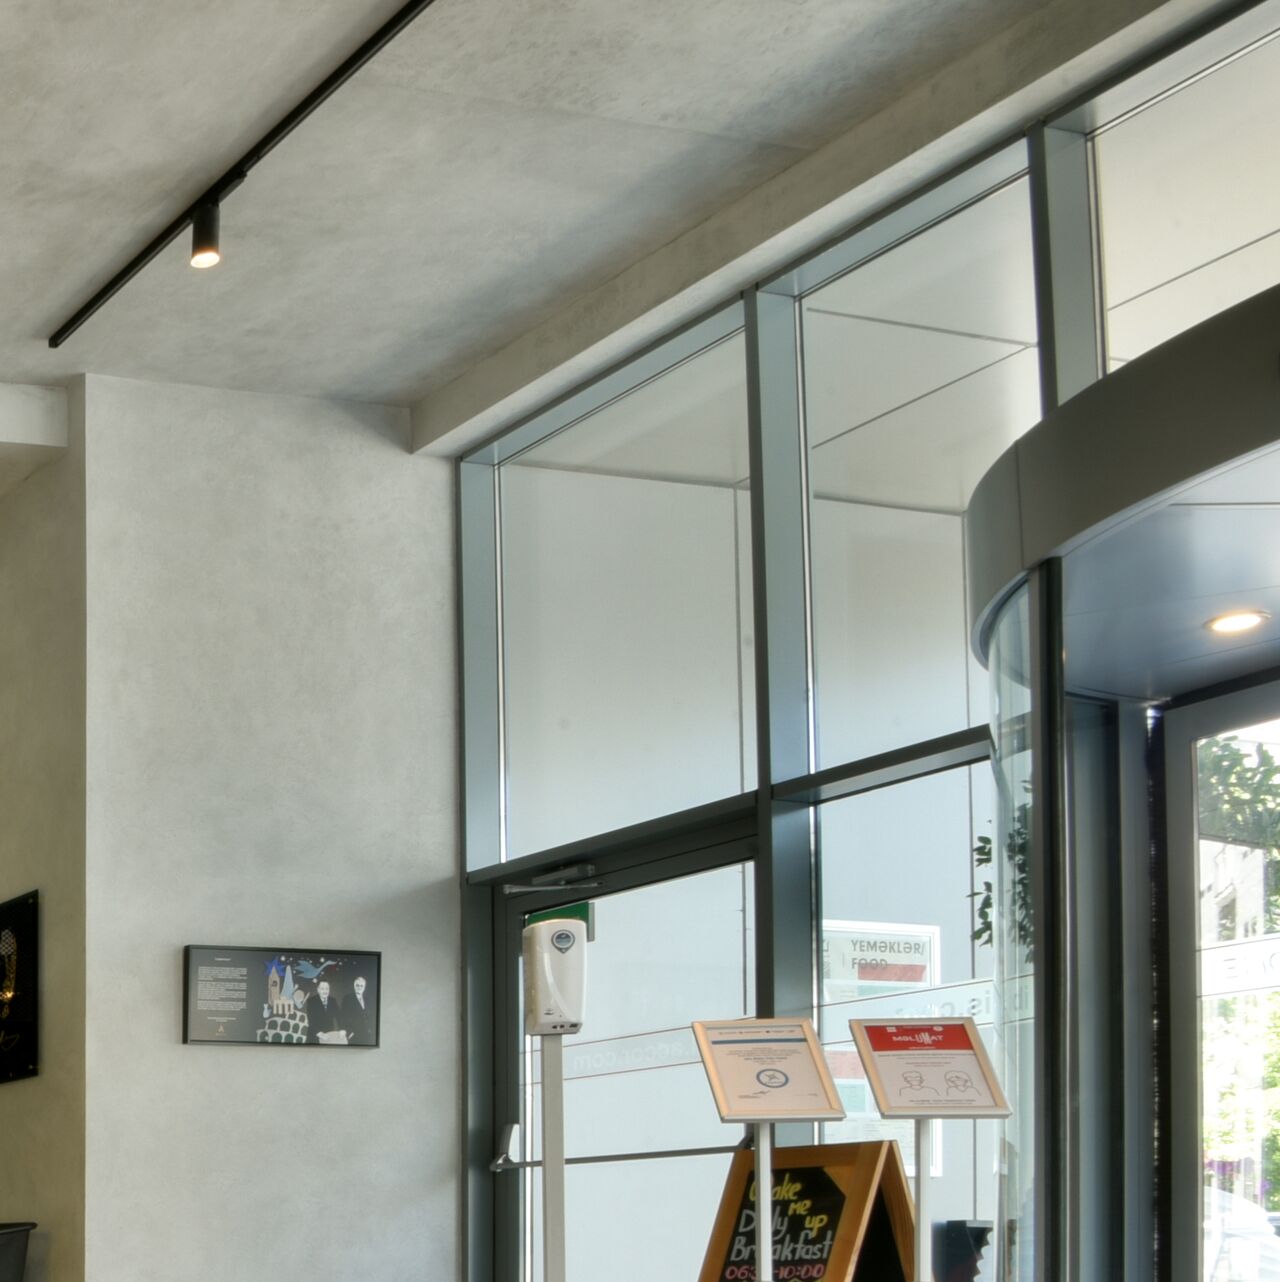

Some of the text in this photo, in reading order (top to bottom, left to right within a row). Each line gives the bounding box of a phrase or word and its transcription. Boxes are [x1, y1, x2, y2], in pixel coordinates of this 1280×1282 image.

[749, 1173, 802, 1202] ake
[738, 1205, 789, 1241] Dly
[730, 1229, 832, 1262] Brakfast
